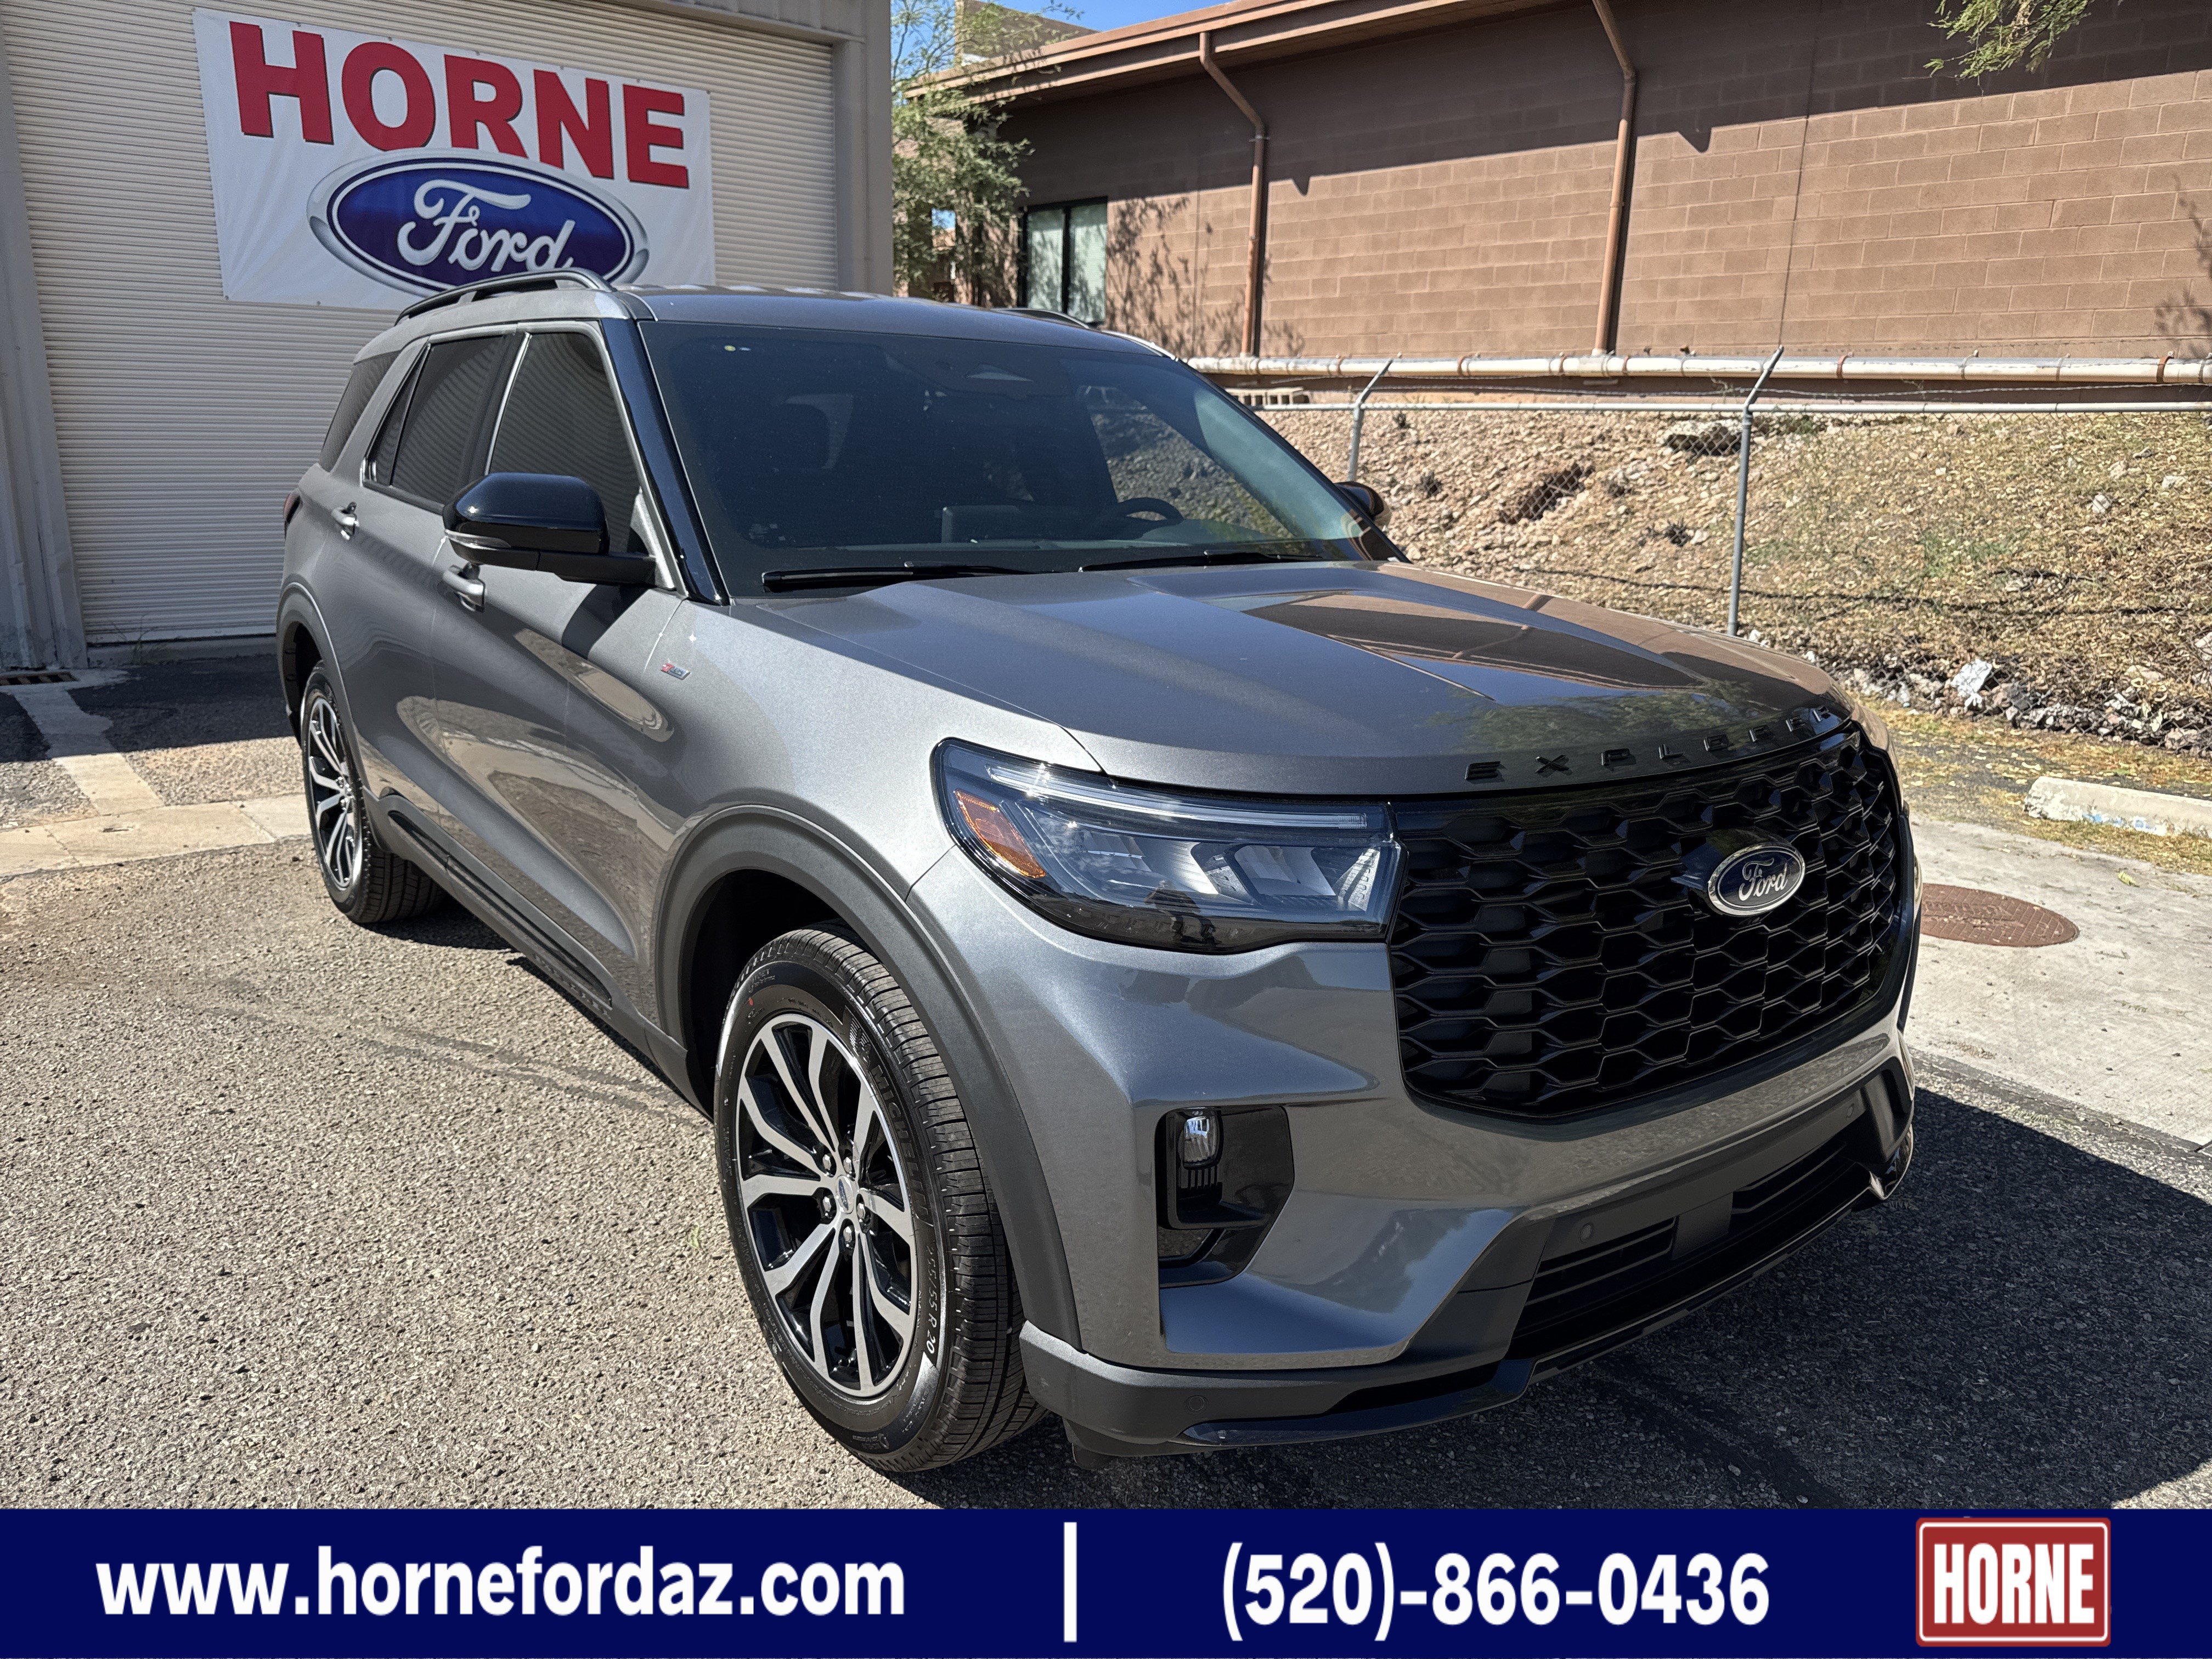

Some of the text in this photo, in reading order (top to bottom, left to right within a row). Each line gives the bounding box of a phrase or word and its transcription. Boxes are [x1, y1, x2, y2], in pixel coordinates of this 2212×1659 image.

[229, 21, 689, 188] HORNE
[397, 179, 575, 272] Ford
[1464, 706, 1830, 780] EXPLORER
[1739, 857, 1788, 901] Ford
[870, 1064, 929, 1216] MICHELIN
